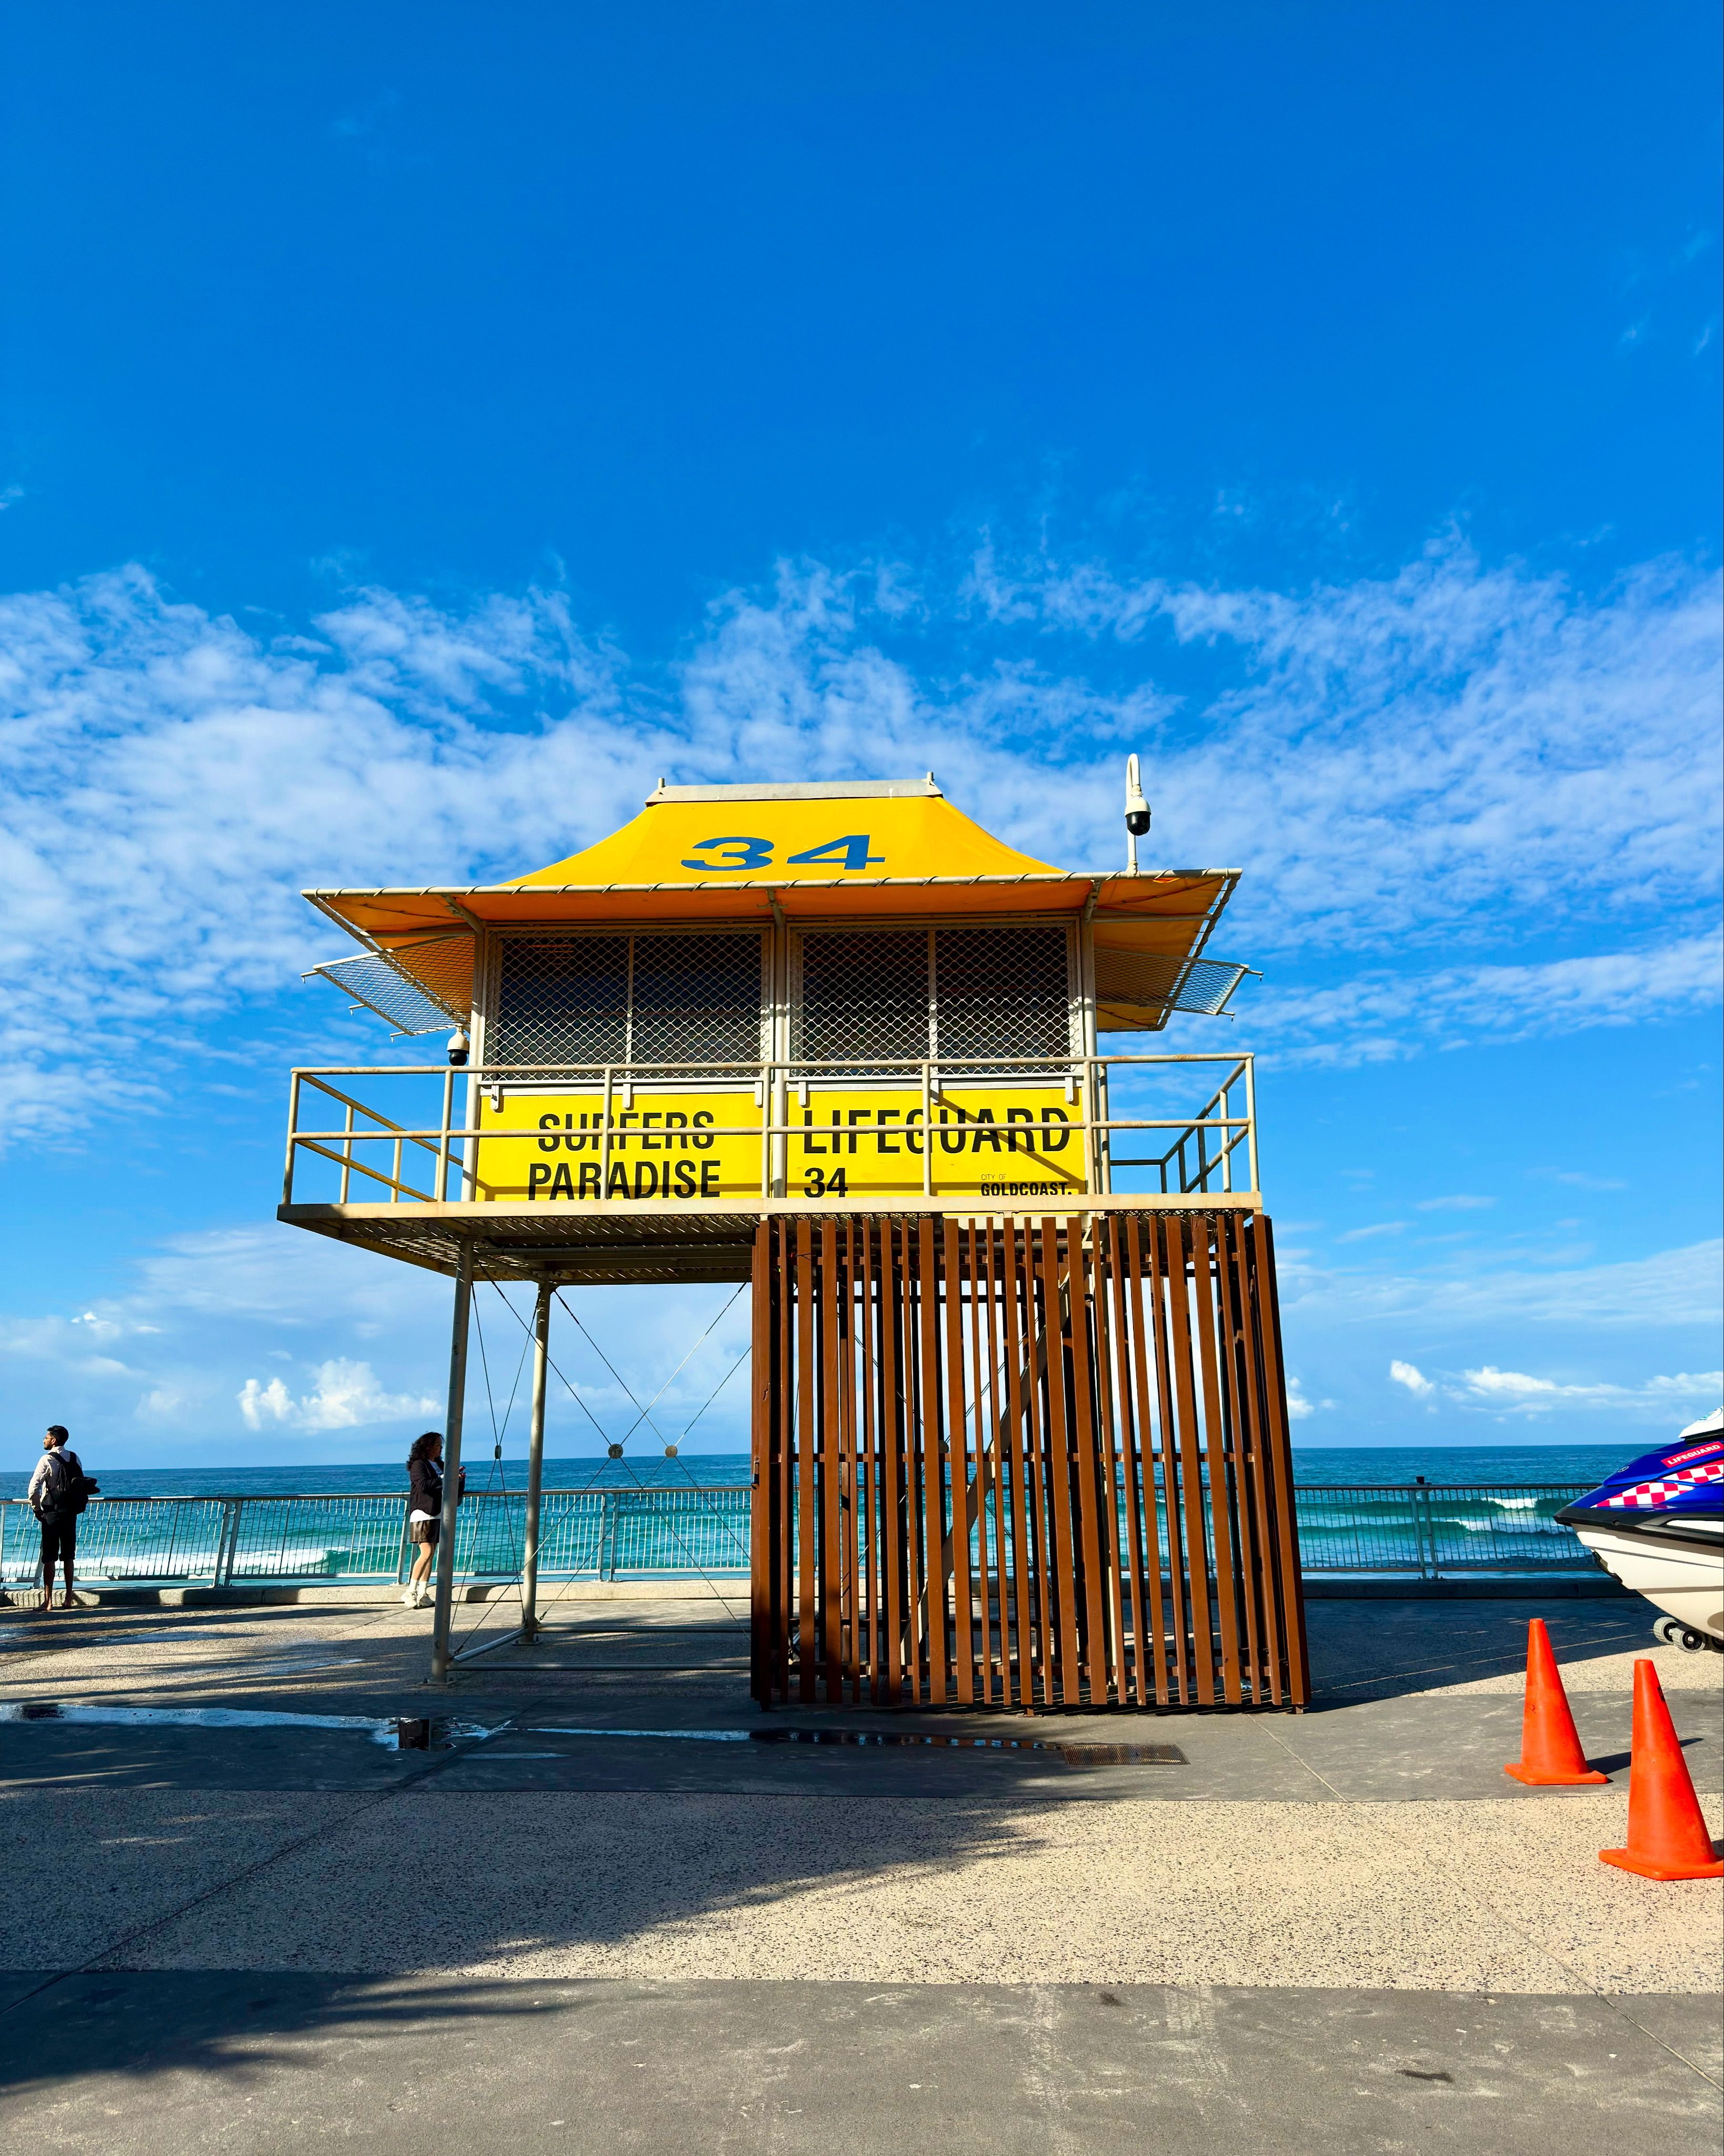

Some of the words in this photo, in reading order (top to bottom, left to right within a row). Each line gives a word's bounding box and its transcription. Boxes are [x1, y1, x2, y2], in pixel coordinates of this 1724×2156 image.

[680, 834, 886, 871] 34
[538, 1111, 715, 1152] SURFERS
[804, 1107, 1070, 1154] LIFEGUARD
[528, 1160, 721, 1200] PARADISE
[804, 1167, 848, 1197] 34
[1667, 1445, 1721, 1465] LIFEGUARD
